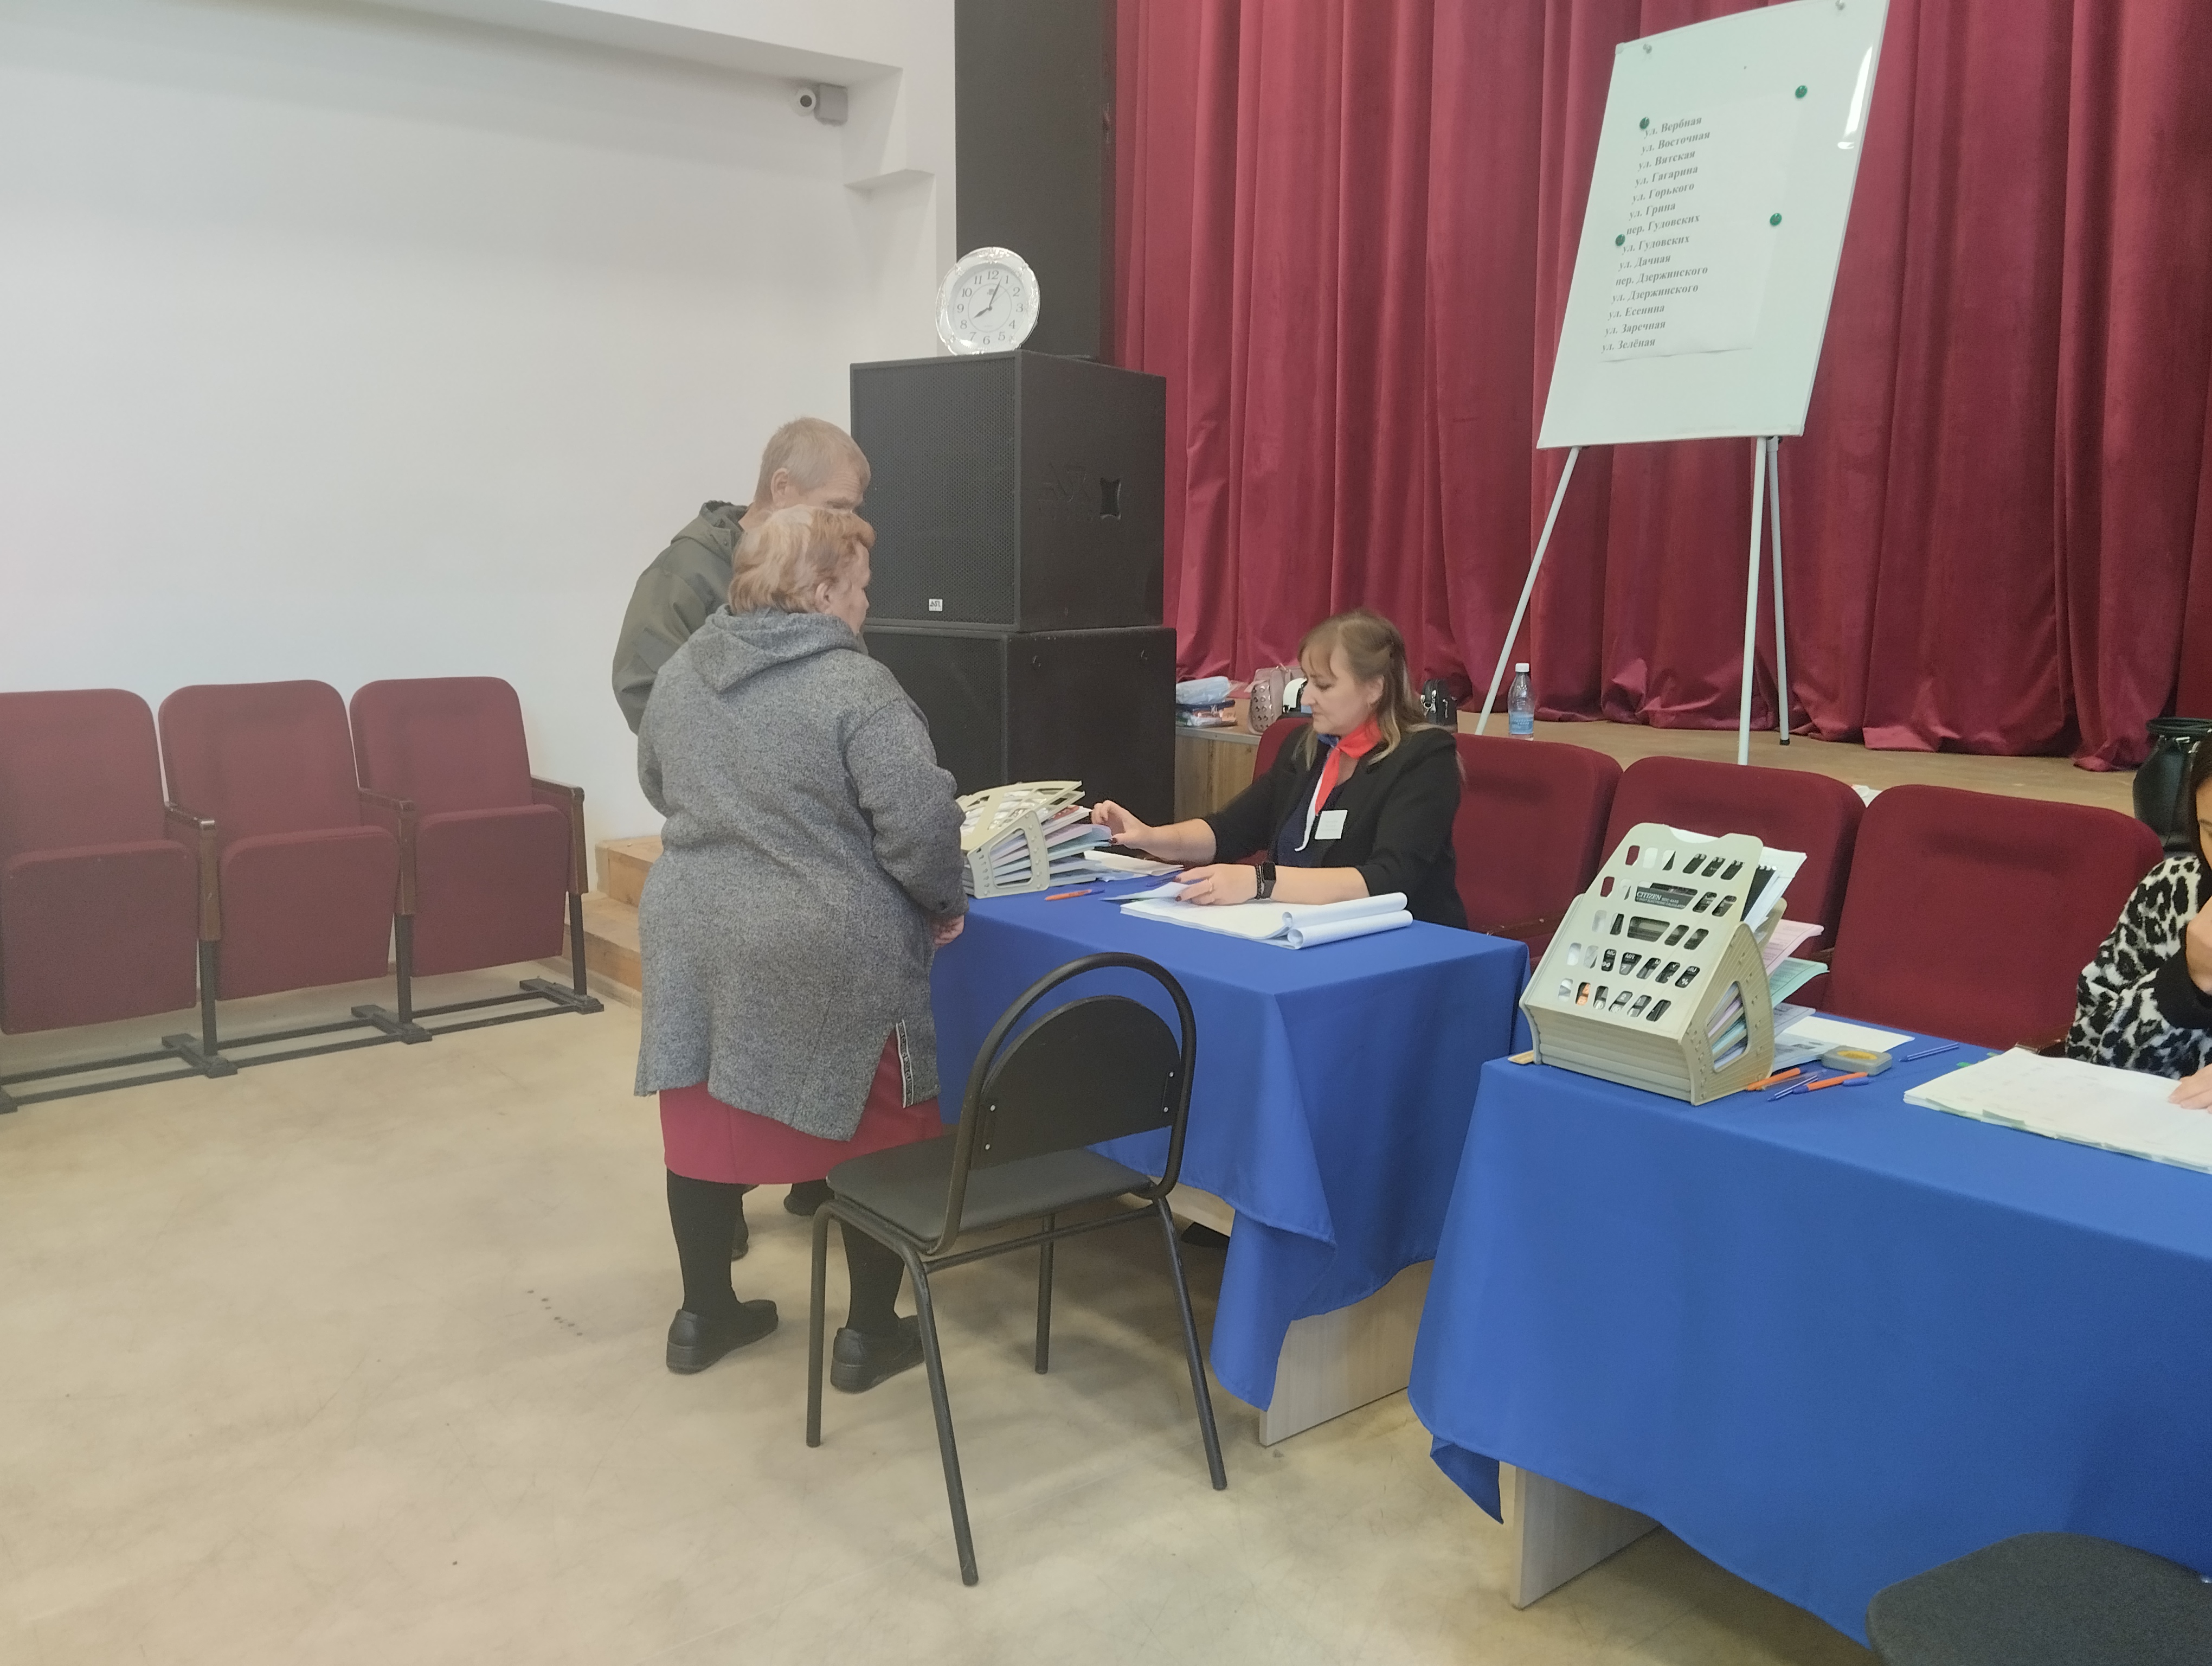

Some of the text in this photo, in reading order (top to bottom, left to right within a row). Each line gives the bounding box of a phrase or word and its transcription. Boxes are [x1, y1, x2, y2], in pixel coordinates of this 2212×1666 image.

[1644, 117, 1702, 139] ул. Вербная
[1641, 132, 1710, 156] ул. Восточная
[1637, 151, 1695, 172] ул. Вятская
[1635, 166, 1698, 189] ул. Гагарина
[1631, 183, 1694, 205] ул. Горького
[1629, 203, 1676, 221] ул. Грина
[1626, 226, 1644, 235] пер.
[1622, 245, 1635, 255] ул.
[1618, 255, 1671, 272] ул. Дачная
[974, 275, 982, 284] 11
[987, 270, 999, 280] 12
[1005, 275, 1009, 284] 1
[1616, 267, 1708, 287] пер. Дзержинского
[962, 288, 973, 297] 10
[1013, 287, 1020, 297] 2
[1611, 285, 1699, 305] ул. Дзержинского
[957, 304, 964, 313] 9
[1016, 303, 1024, 312] 3
[1607, 305, 1664, 321] ул. Есенина
[960, 319, 967, 329] 8
[1009, 319, 1015, 329] 4
[1604, 322, 1666, 338] ул. Заречная
[970, 332, 977, 341] 7
[983, 336, 990, 345] 6
[998, 331, 1005, 341] 5
[1601, 339, 1656, 354] ул. Зелёная
[1636, 891, 1662, 900] CITIZEN
